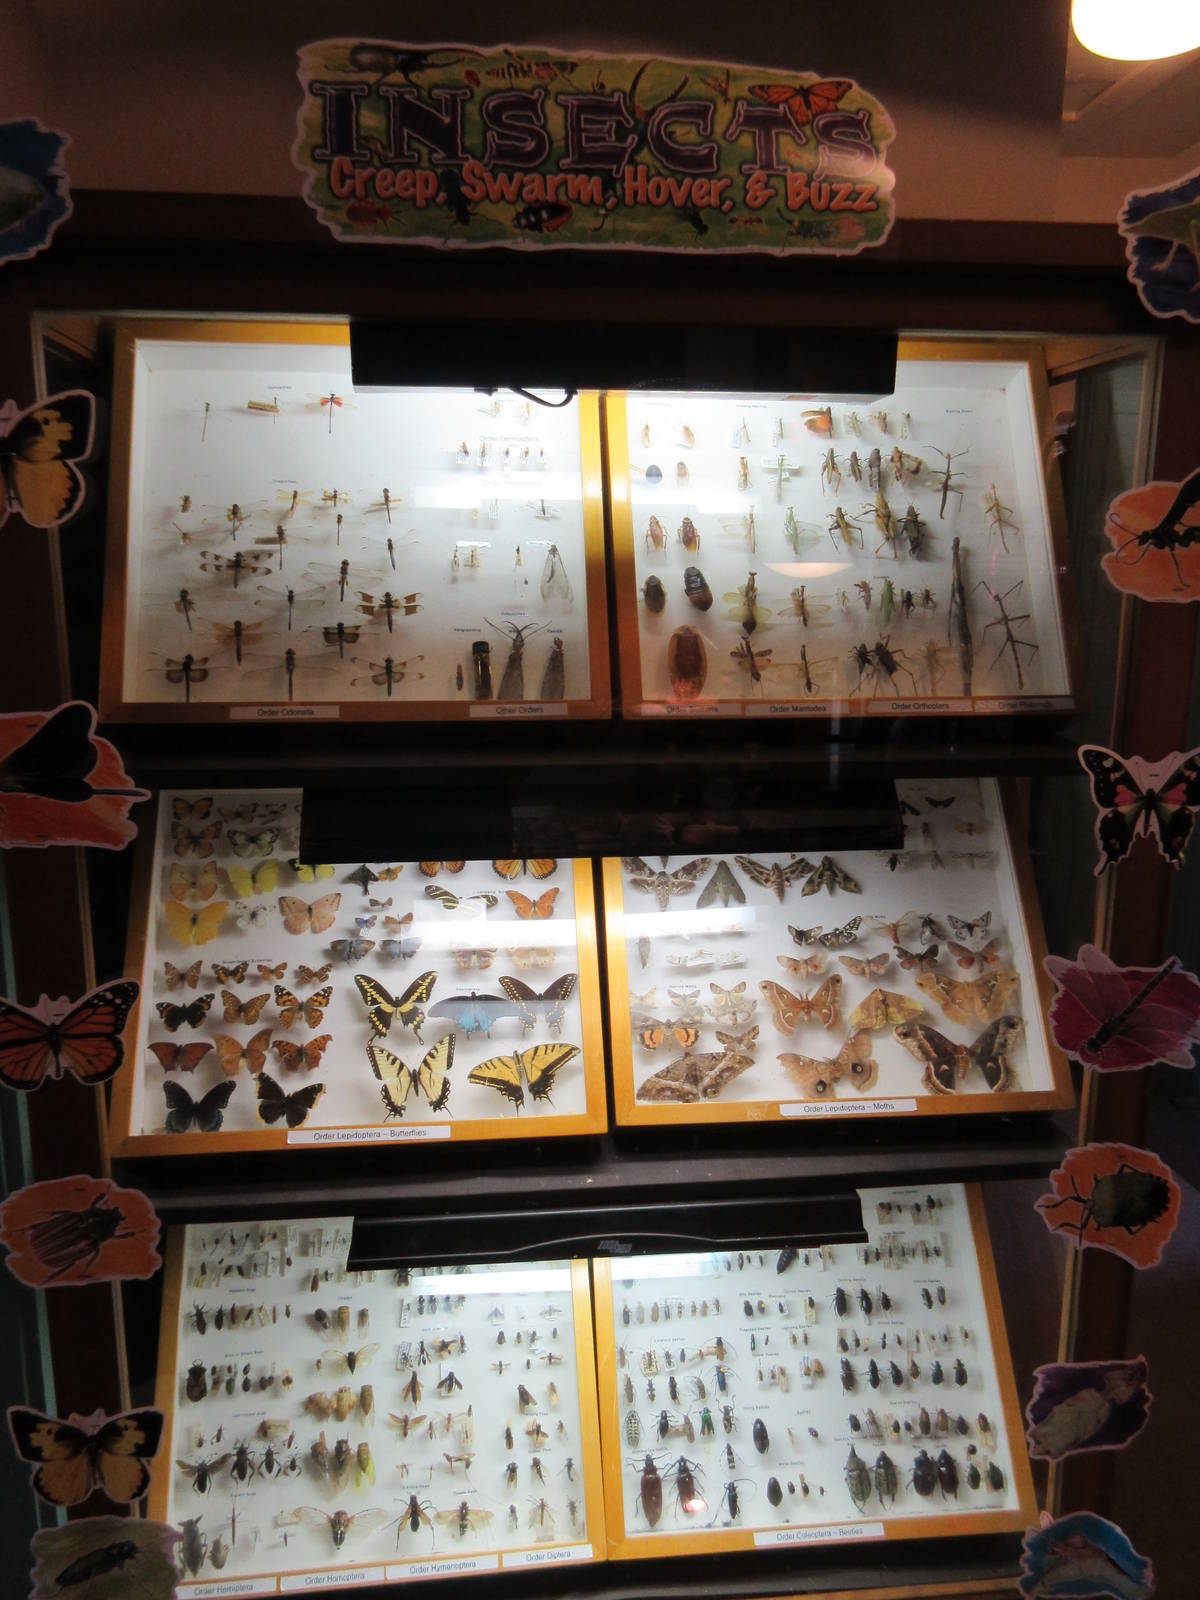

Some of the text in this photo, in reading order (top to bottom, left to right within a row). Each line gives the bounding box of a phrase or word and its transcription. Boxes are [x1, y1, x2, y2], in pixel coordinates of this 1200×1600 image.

[311, 84, 876, 181] INSECTS
[330, 156, 878, 213] Creep, Swarm, Hover, & Buzz
[518, 706, 545, 714] Orders
[769, 705, 790, 713] Order
[891, 703, 911, 711] Order
[256, 708, 280, 717] Order
[803, 1105, 823, 1113] Order
[825, 1104, 866, 1114] Lepidoptera
[873, 1102, 895, 1110] Moths
[313, 1132, 336, 1141] Order
[337, 1130, 381, 1141] Lepidoptera
[390, 1129, 427, 1138] Butterflies
[776, 1533, 795, 1541] Order
[525, 1550, 572, 1562] Order Diptera
[409, 1560, 476, 1574] Order Hymenoptera
[304, 1576, 326, 1585] Order
[194, 1586, 216, 1595] Order
